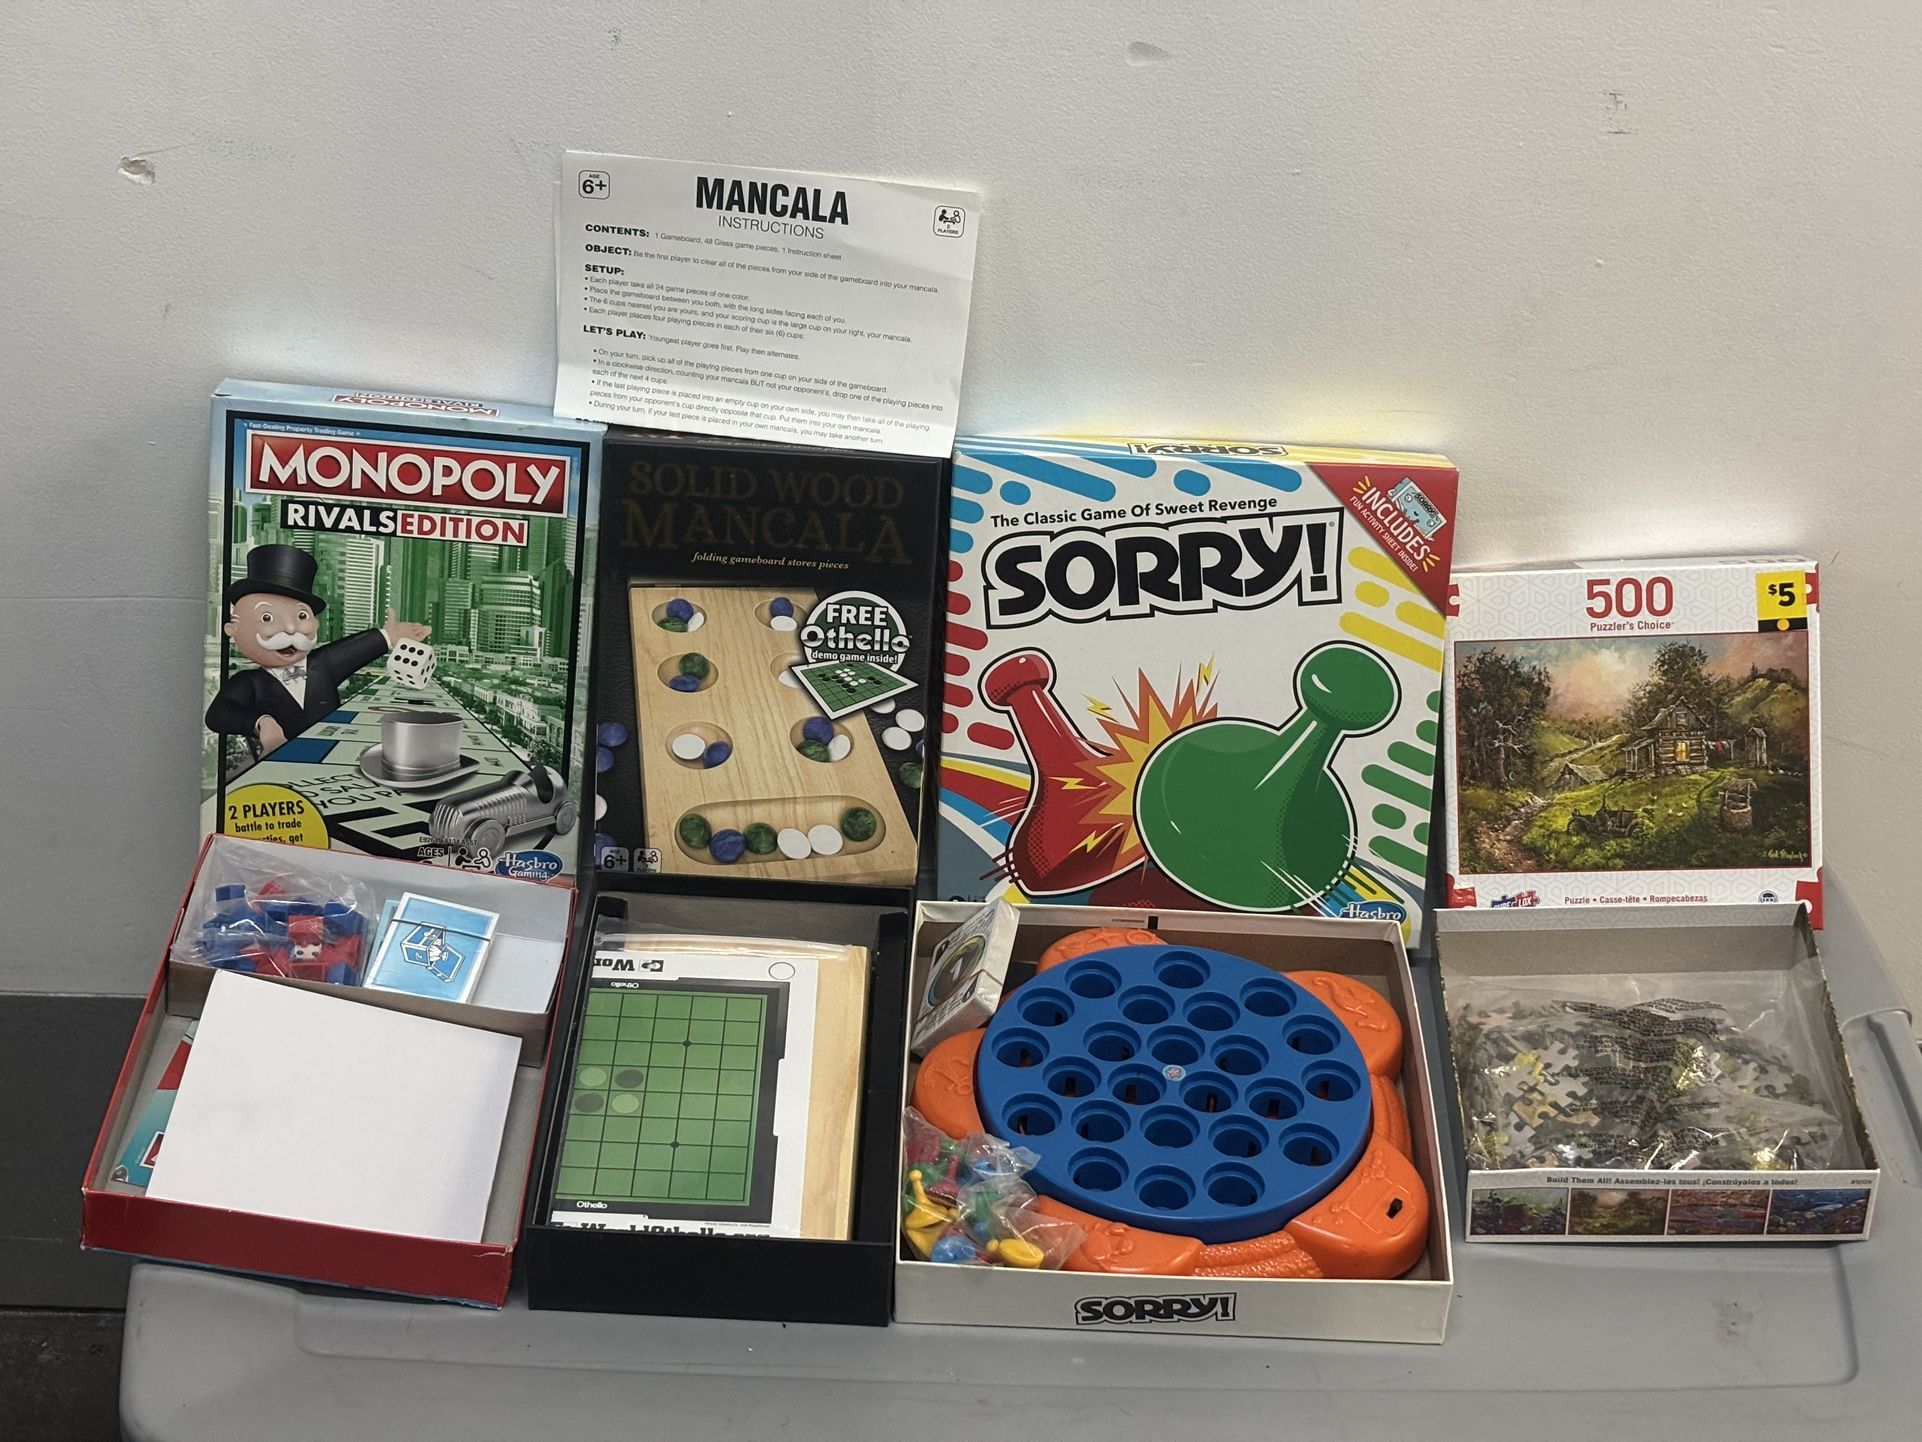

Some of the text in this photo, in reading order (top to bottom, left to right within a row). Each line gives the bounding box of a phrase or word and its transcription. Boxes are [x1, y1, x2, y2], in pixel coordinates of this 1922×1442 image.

[583, 180, 607, 194] 6+
[696, 176, 849, 225] MANCALA
[718, 215, 824, 239] INSTRUCTIONS
[584, 224, 650, 237] CONTENTS:
[714, 239, 733, 247] Glass
[734, 242, 754, 251] game
[787, 247, 821, 257] Instruction
[822, 251, 842, 259] sheet
[584, 244, 632, 256] OBJECT:
[670, 254, 691, 264] player
[700, 258, 717, 266] clear
[747, 263, 770, 274] pieces
[771, 266, 786, 274] from
[787, 269, 803, 277] your
[839, 274, 878, 286] gameboard
[892, 281, 908, 290] your
[584, 264, 624, 275] SETUP:
[589, 276, 607, 284] Each
[608, 278, 629, 288] player
[664, 286, 684, 294] game
[685, 287, 708, 297] pieces
[589, 286, 608, 294] Place
[621, 289, 660, 302] gameboard
[661, 294, 690, 304] between
[690, 299, 703, 307] you
[722, 302, 736, 310] with
[749, 305, 764, 314] long
[765, 307, 783, 315] sides
[784, 309, 805, 319] facing
[806, 312, 823, 320] each
[588, 306, 606, 314] Each
[607, 308, 628, 318] player
[628, 311, 651, 321] places
[666, 315, 691, 326] playing
[692, 319, 715, 329] pieces
[723, 322, 740, 331] each
[749, 325, 764, 334] their
[775, 329, 786, 338] (6)
[582, 324, 613, 335] LET'S
[615, 328, 646, 339] PLAY:
[648, 334, 680, 346] Youngest
[680, 338, 701, 348] player
[702, 342, 719, 351] goes
[735, 345, 750, 354] Play
[750, 347, 765, 355] then
[338, 396, 492, 414] MONOPOLY
[249, 422, 285, 431] Fast-Dealing
[286, 425, 313, 433] Property
[314, 427, 335, 435] Trading
[1134, 444, 1284, 455] SORRY!
[259, 442, 560, 506] MONOPOLY
[629, 460, 757, 500] SOLID
[769, 468, 906, 508] WOOD
[286, 502, 525, 544] RIVALS EDITION
[991, 498, 1278, 528] The Classic Game Of Sweet Revenge
[1362, 487, 1430, 560] INCLUDES
[620, 498, 912, 564] MANCALA
[1350, 496, 1418, 572] FUN ACTIVITY SHEET INSIDE!
[691, 552, 849, 570] folding gameboard stores pieces
[994, 521, 1328, 616] SORRY!
[1586, 576, 1674, 618] 500
[1768, 582, 1796, 606] $5
[826, 604, 888, 626] FREE
[1590, 620, 1671, 632] Puzzler's Choice
[800, 625, 910, 653] Othello
[812, 650, 898, 664] demo game inside!
[286, 774, 361, 789] LLECT
[228, 800, 304, 820] 2 PLAYERS
[235, 818, 302, 832] battle to trade
[417, 847, 445, 857] AGES
[499, 852, 558, 870] Hasbro
[604, 854, 627, 869] 6+
[509, 867, 549, 880] Gaming
[1600, 895, 1640, 903] Casse-tête
[1650, 894, 1708, 903] Rompecabezas
[1343, 904, 1401, 920] Hasbro
[576, 1201, 608, 1209] Othello
[1080, 1296, 1230, 1322] SORRY!
